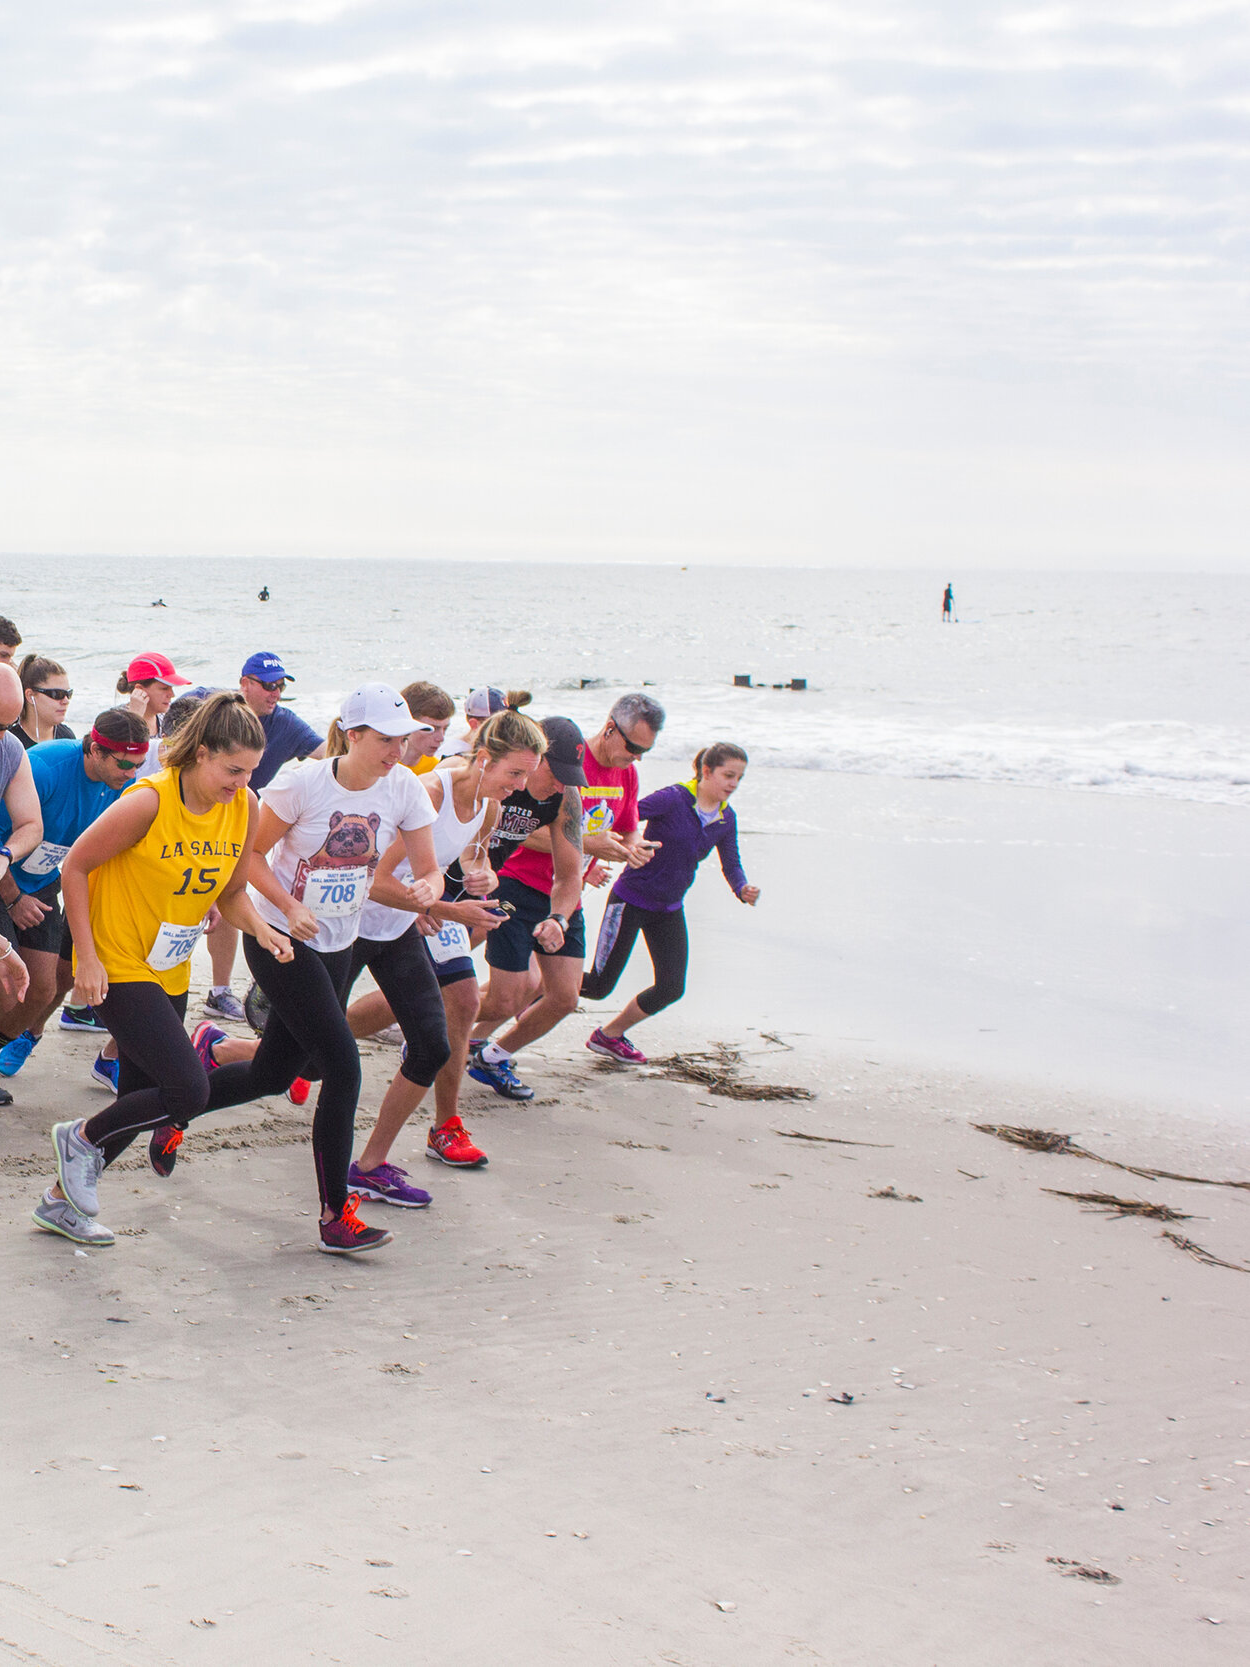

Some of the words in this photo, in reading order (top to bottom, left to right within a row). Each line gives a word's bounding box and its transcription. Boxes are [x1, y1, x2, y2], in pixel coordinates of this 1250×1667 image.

[160, 841, 184, 859] LA
[190, 840, 241, 858] SALLE
[173, 867, 220, 895] 15
[319, 883, 356, 904] 708
[165, 936, 197, 958] 709
[437, 926, 467, 948] 931
